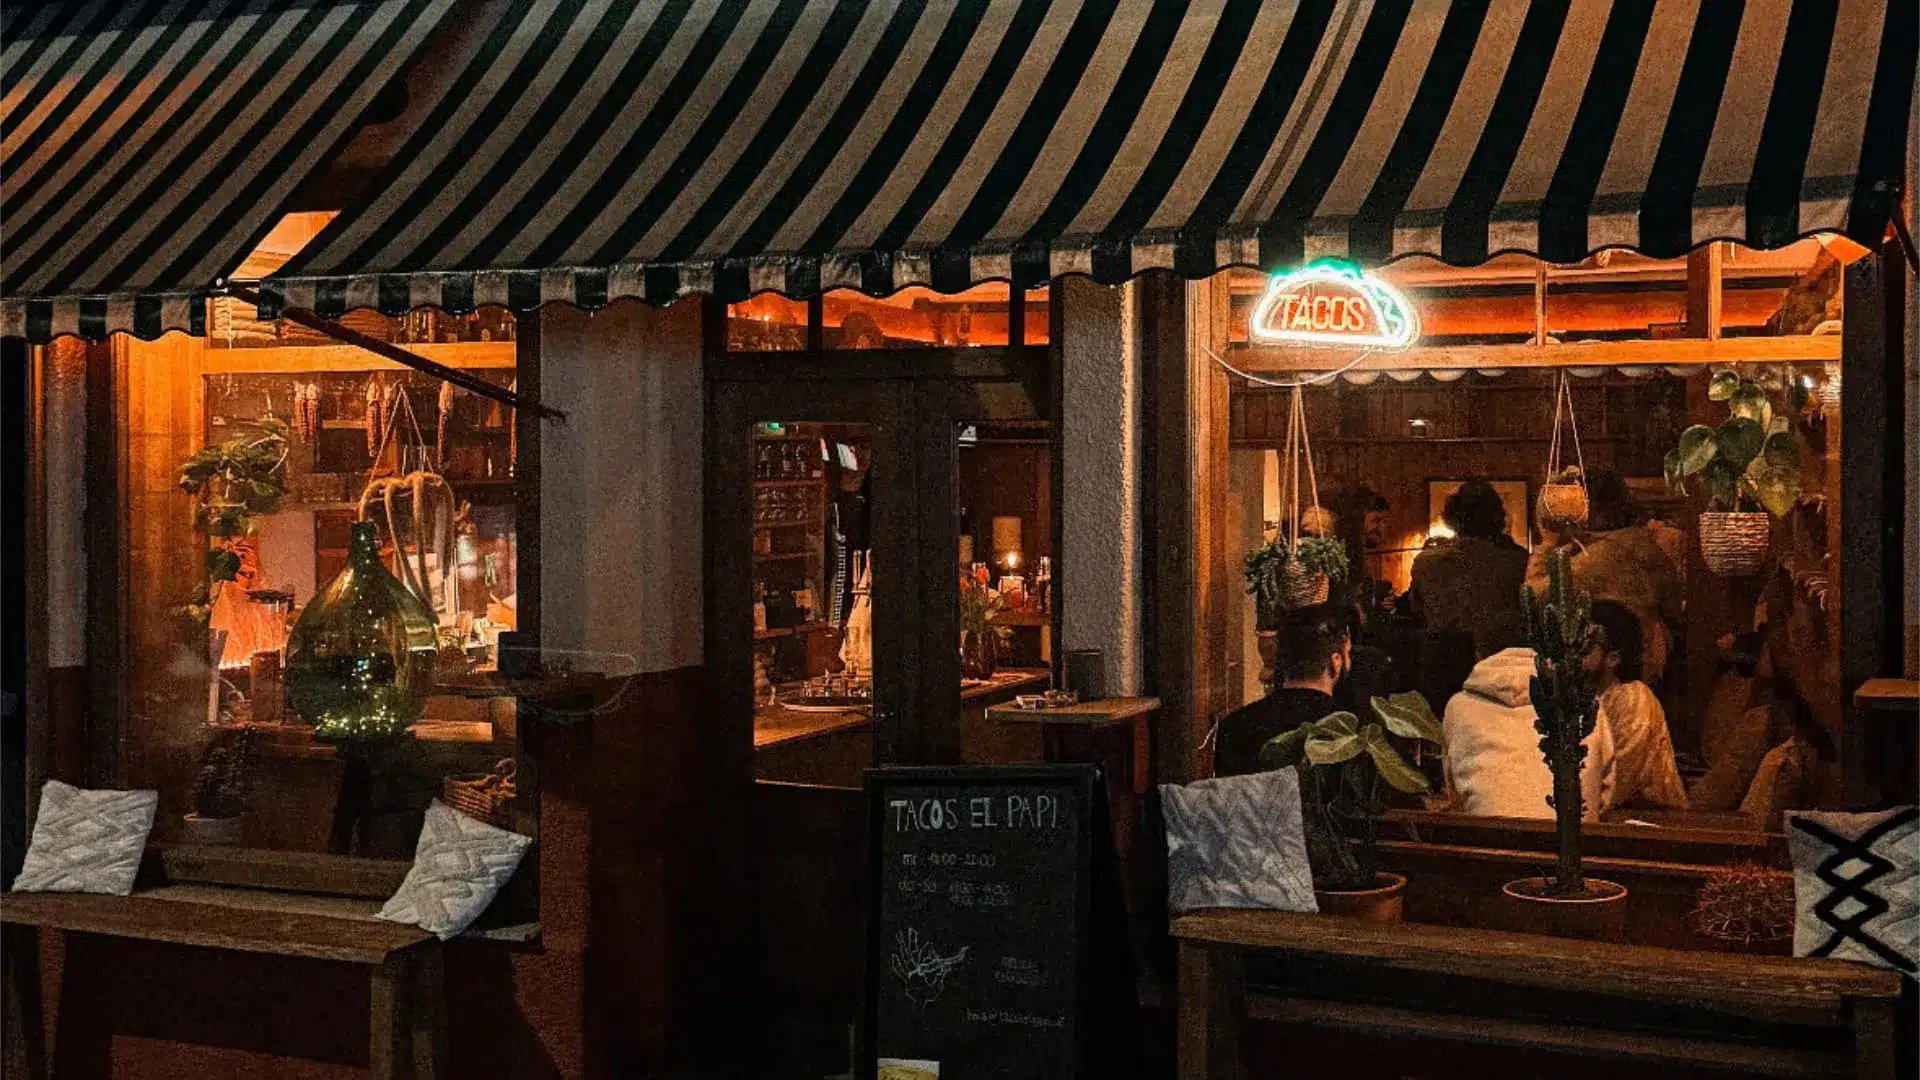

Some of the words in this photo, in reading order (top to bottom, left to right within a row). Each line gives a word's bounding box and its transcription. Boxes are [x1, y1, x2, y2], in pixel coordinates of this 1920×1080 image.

[1279, 294, 1367, 331] TACOS
[890, 799, 958, 832] TACOS
[969, 797, 998, 828] EL
[1007, 795, 1057, 829] PAPI
